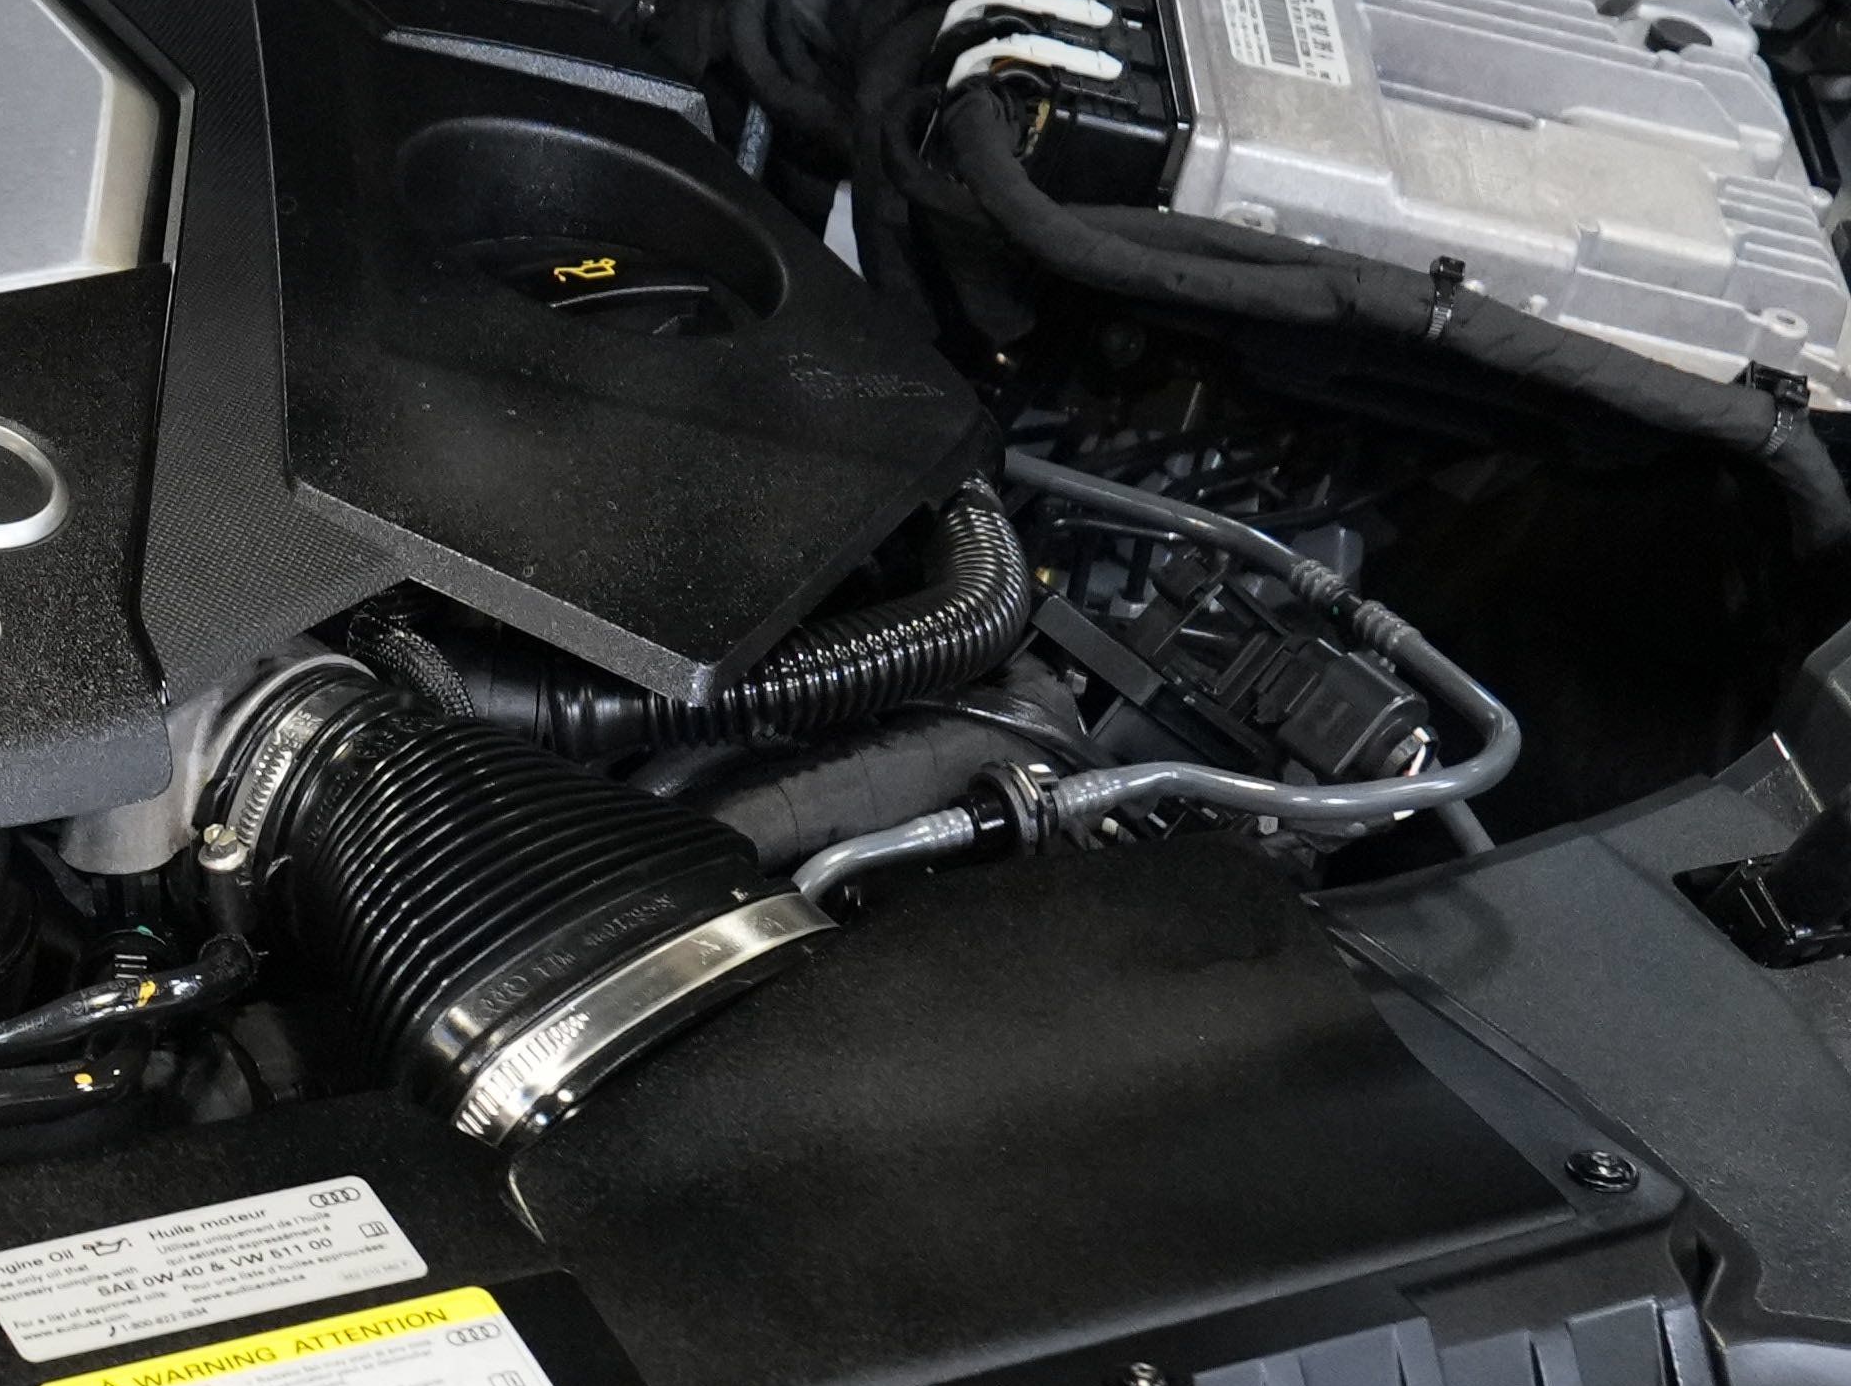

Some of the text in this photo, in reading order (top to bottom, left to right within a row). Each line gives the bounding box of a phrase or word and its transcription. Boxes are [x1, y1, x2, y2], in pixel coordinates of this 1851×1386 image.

[147, 1207, 268, 1241] Huile moteur
[201, 1222, 276, 1245] uniquement
[46, 1248, 75, 1262] Oil
[96, 1237, 334, 1296] SAE 0W-40 & VW 511 00
[111, 1265, 138, 1277] with
[288, 1306, 449, 1354] ATTENTION
